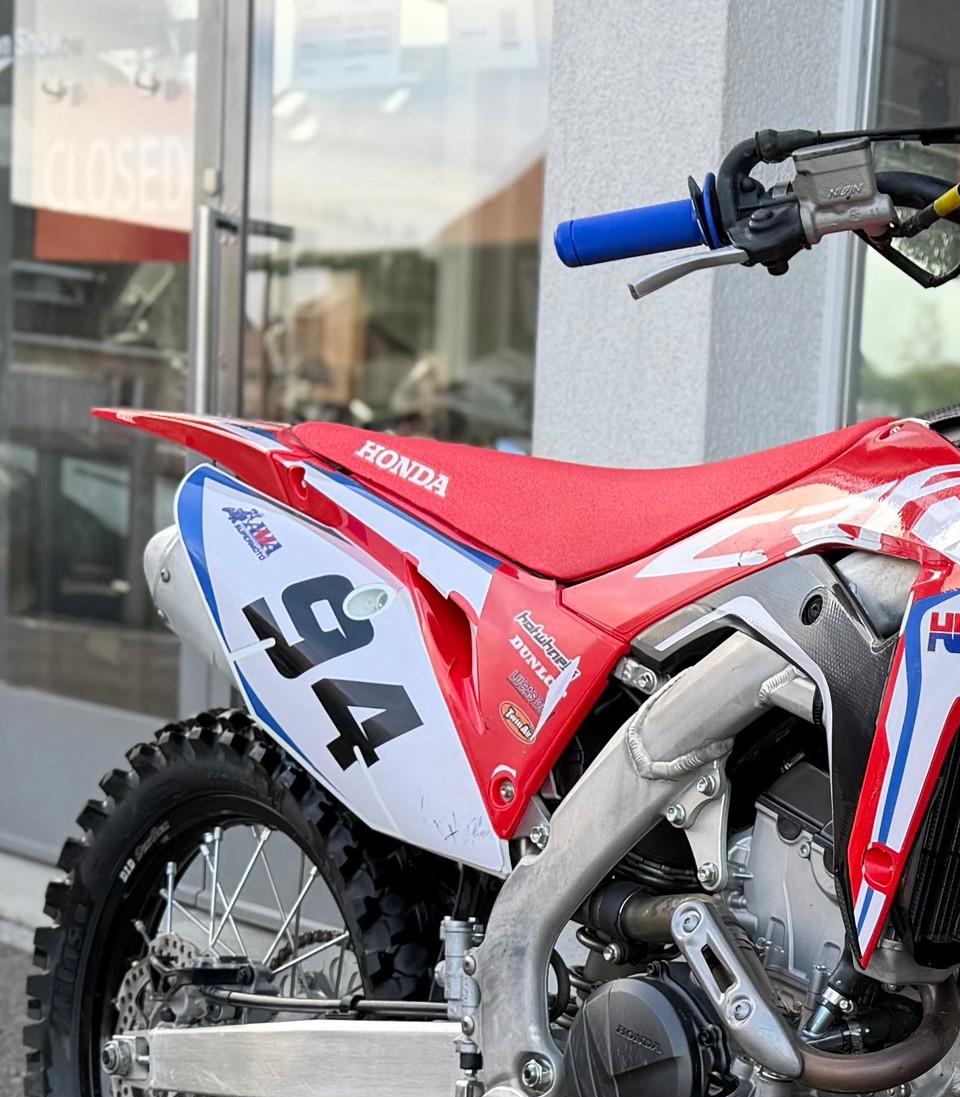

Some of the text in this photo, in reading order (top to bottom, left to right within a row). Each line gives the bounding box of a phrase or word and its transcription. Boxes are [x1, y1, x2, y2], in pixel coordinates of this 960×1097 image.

[44, 136, 186, 212] CLOSED
[355, 440, 449, 498] HONDA
[243, 521, 282, 557] AMA
[508, 634, 567, 698] DUNLO
